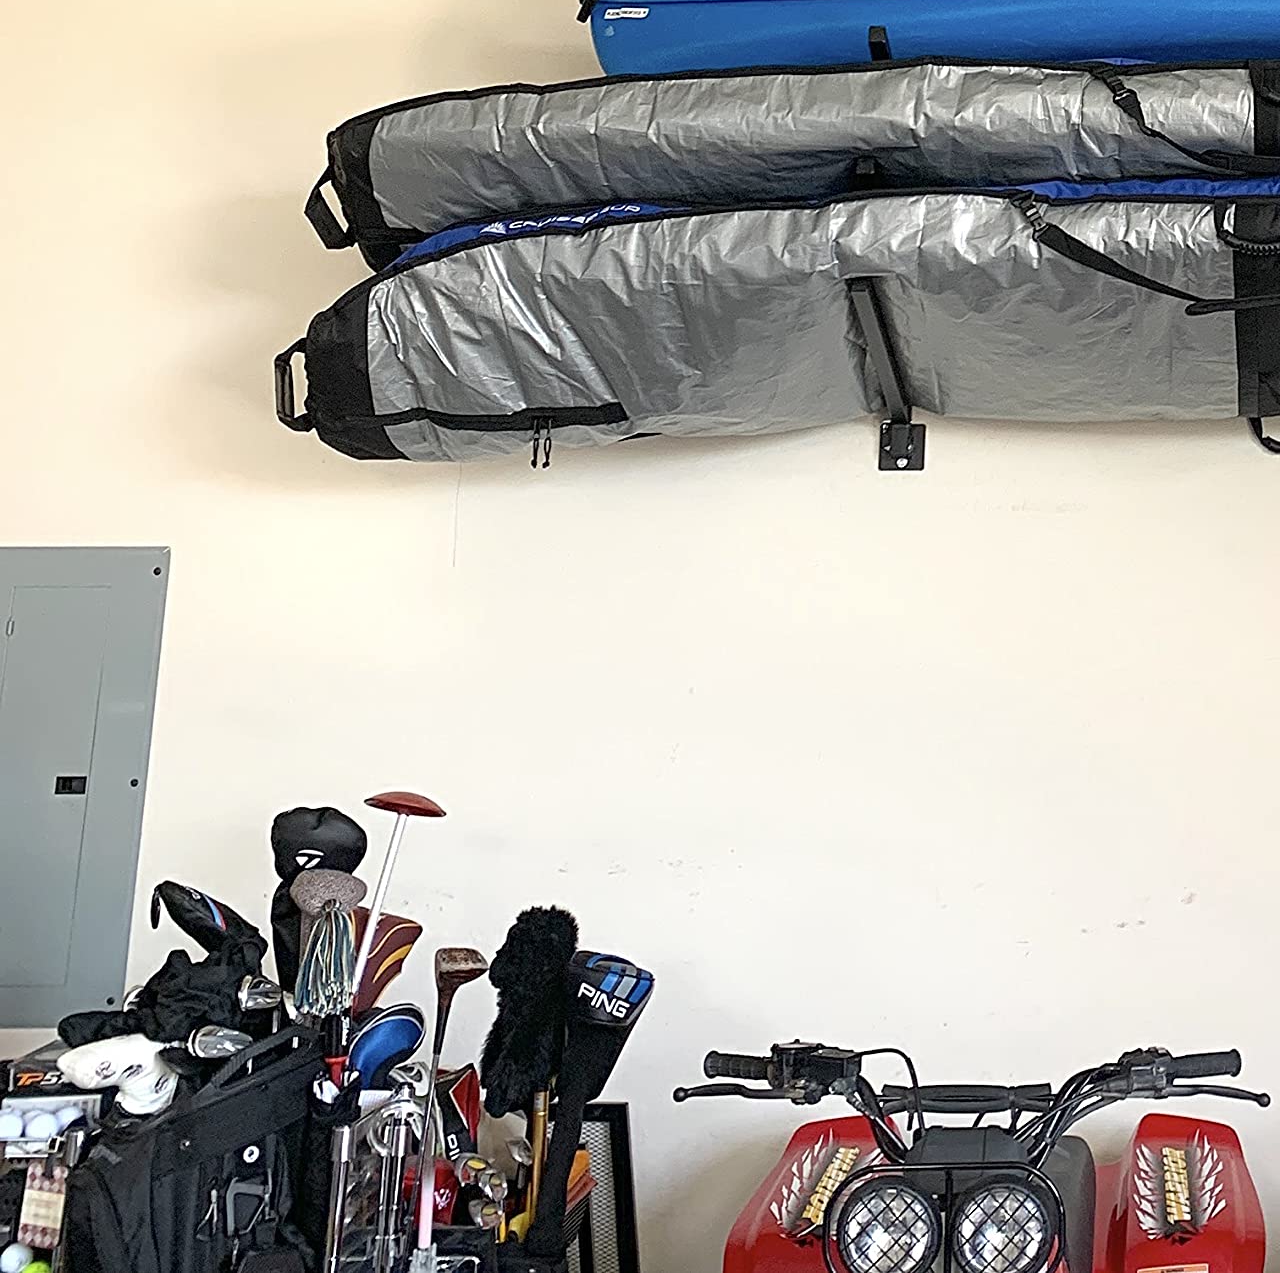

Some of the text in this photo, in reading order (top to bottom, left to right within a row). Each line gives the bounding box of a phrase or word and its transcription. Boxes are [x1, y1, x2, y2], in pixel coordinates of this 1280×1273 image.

[577, 982, 631, 1018] PING
[802, 1147, 860, 1225] WARRIOR
[1162, 1147, 1191, 1225] WARRIOR
